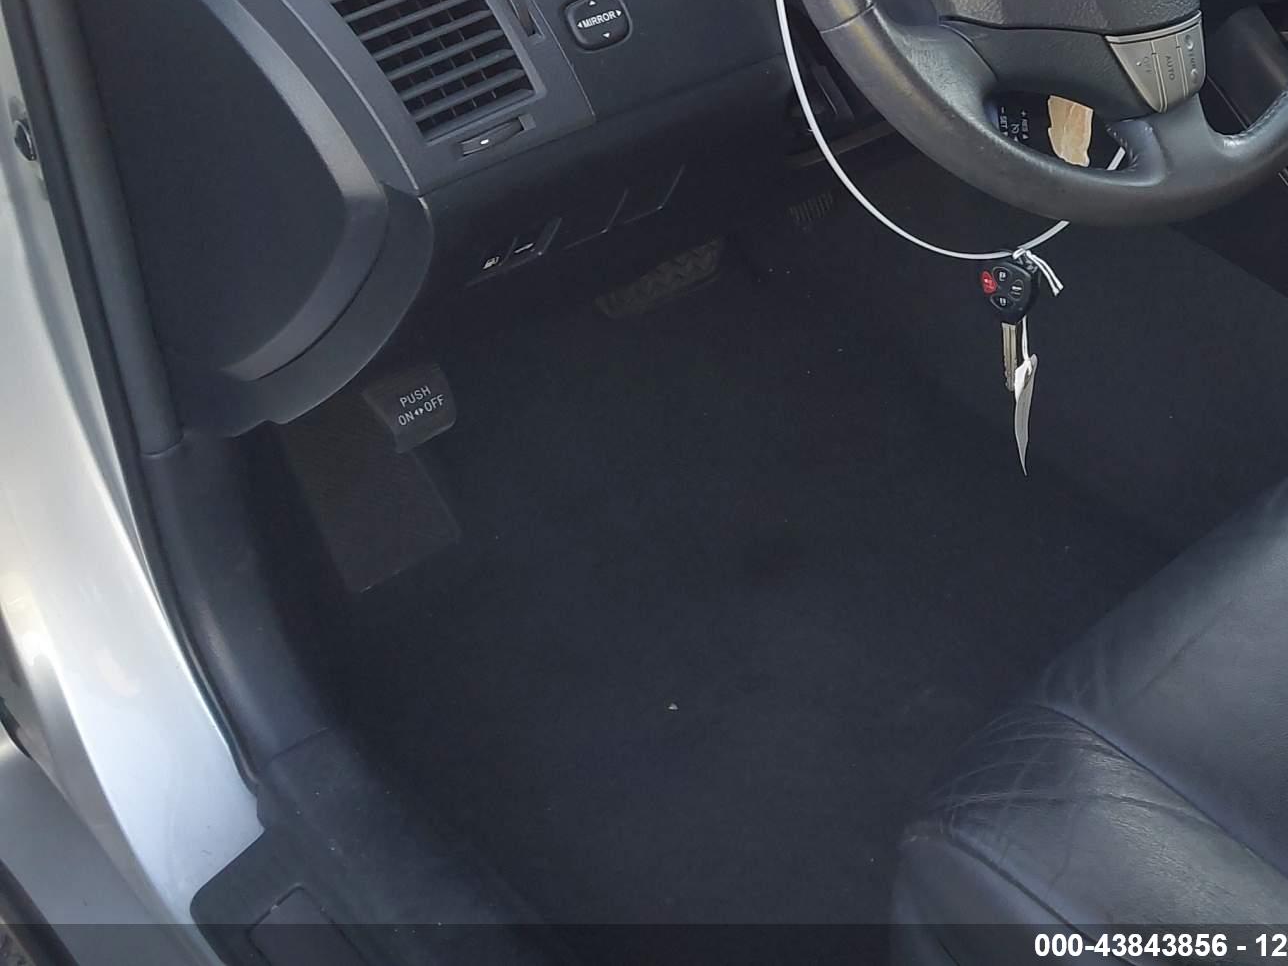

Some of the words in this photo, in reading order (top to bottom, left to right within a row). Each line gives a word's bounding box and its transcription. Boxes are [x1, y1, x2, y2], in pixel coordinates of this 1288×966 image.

[582, 10, 616, 28] MIRROR
[400, 385, 431, 408] PUSH
[398, 411, 415, 426] ON
[424, 394, 444, 412] OFF
